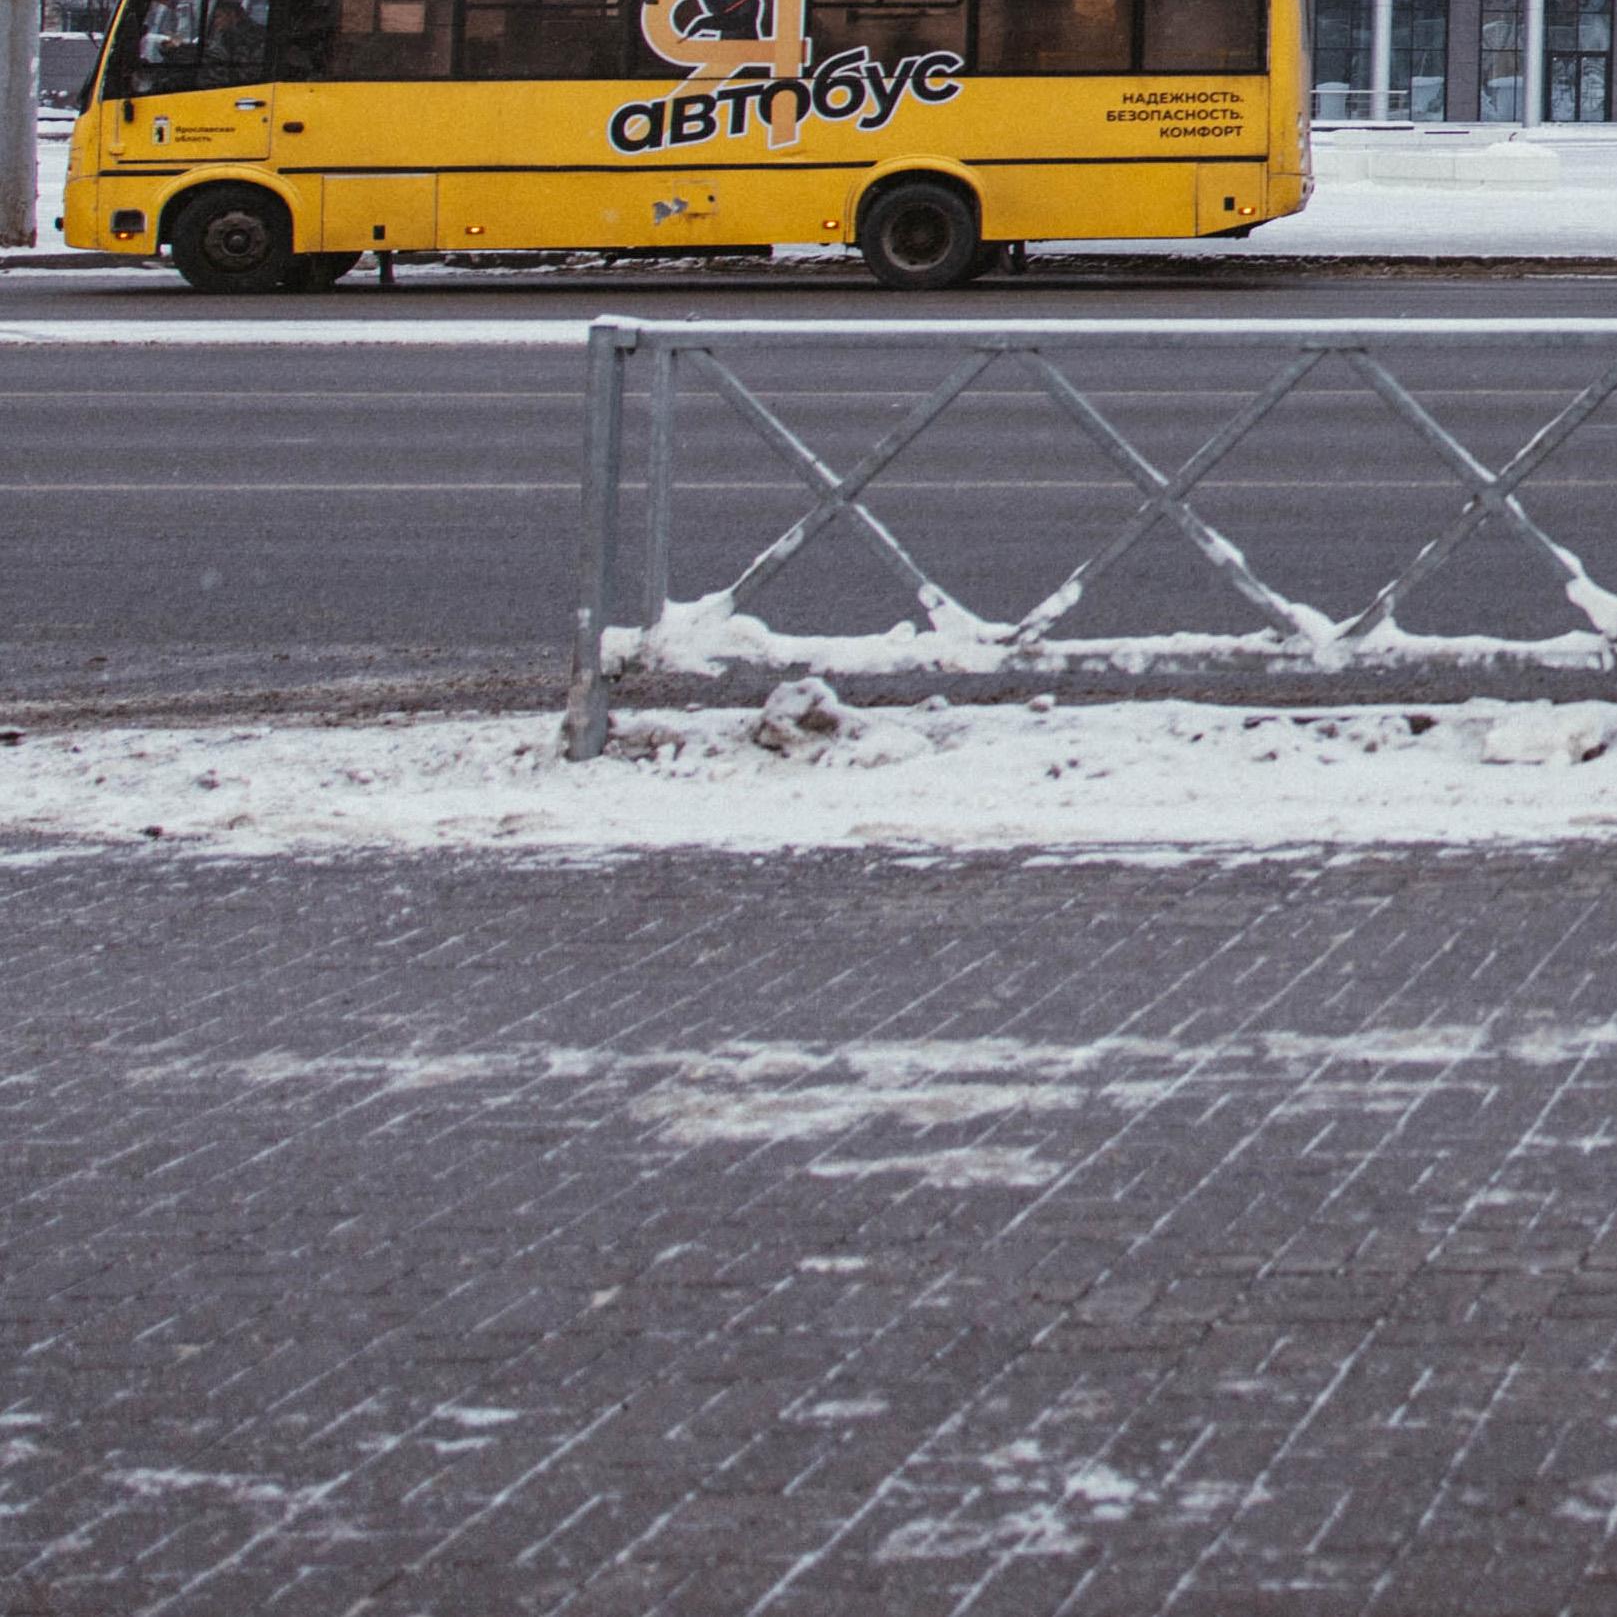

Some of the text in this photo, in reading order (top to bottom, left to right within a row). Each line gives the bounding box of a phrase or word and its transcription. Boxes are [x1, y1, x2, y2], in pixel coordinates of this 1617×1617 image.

[608, 45, 965, 155] автобус
[1122, 91, 1244, 105] НАДЕЖНОСТЬ.
[1105, 108, 1244, 122] БЕЗОПАСНОСТЬ.
[1159, 125, 1243, 139] КОМФОРТ
